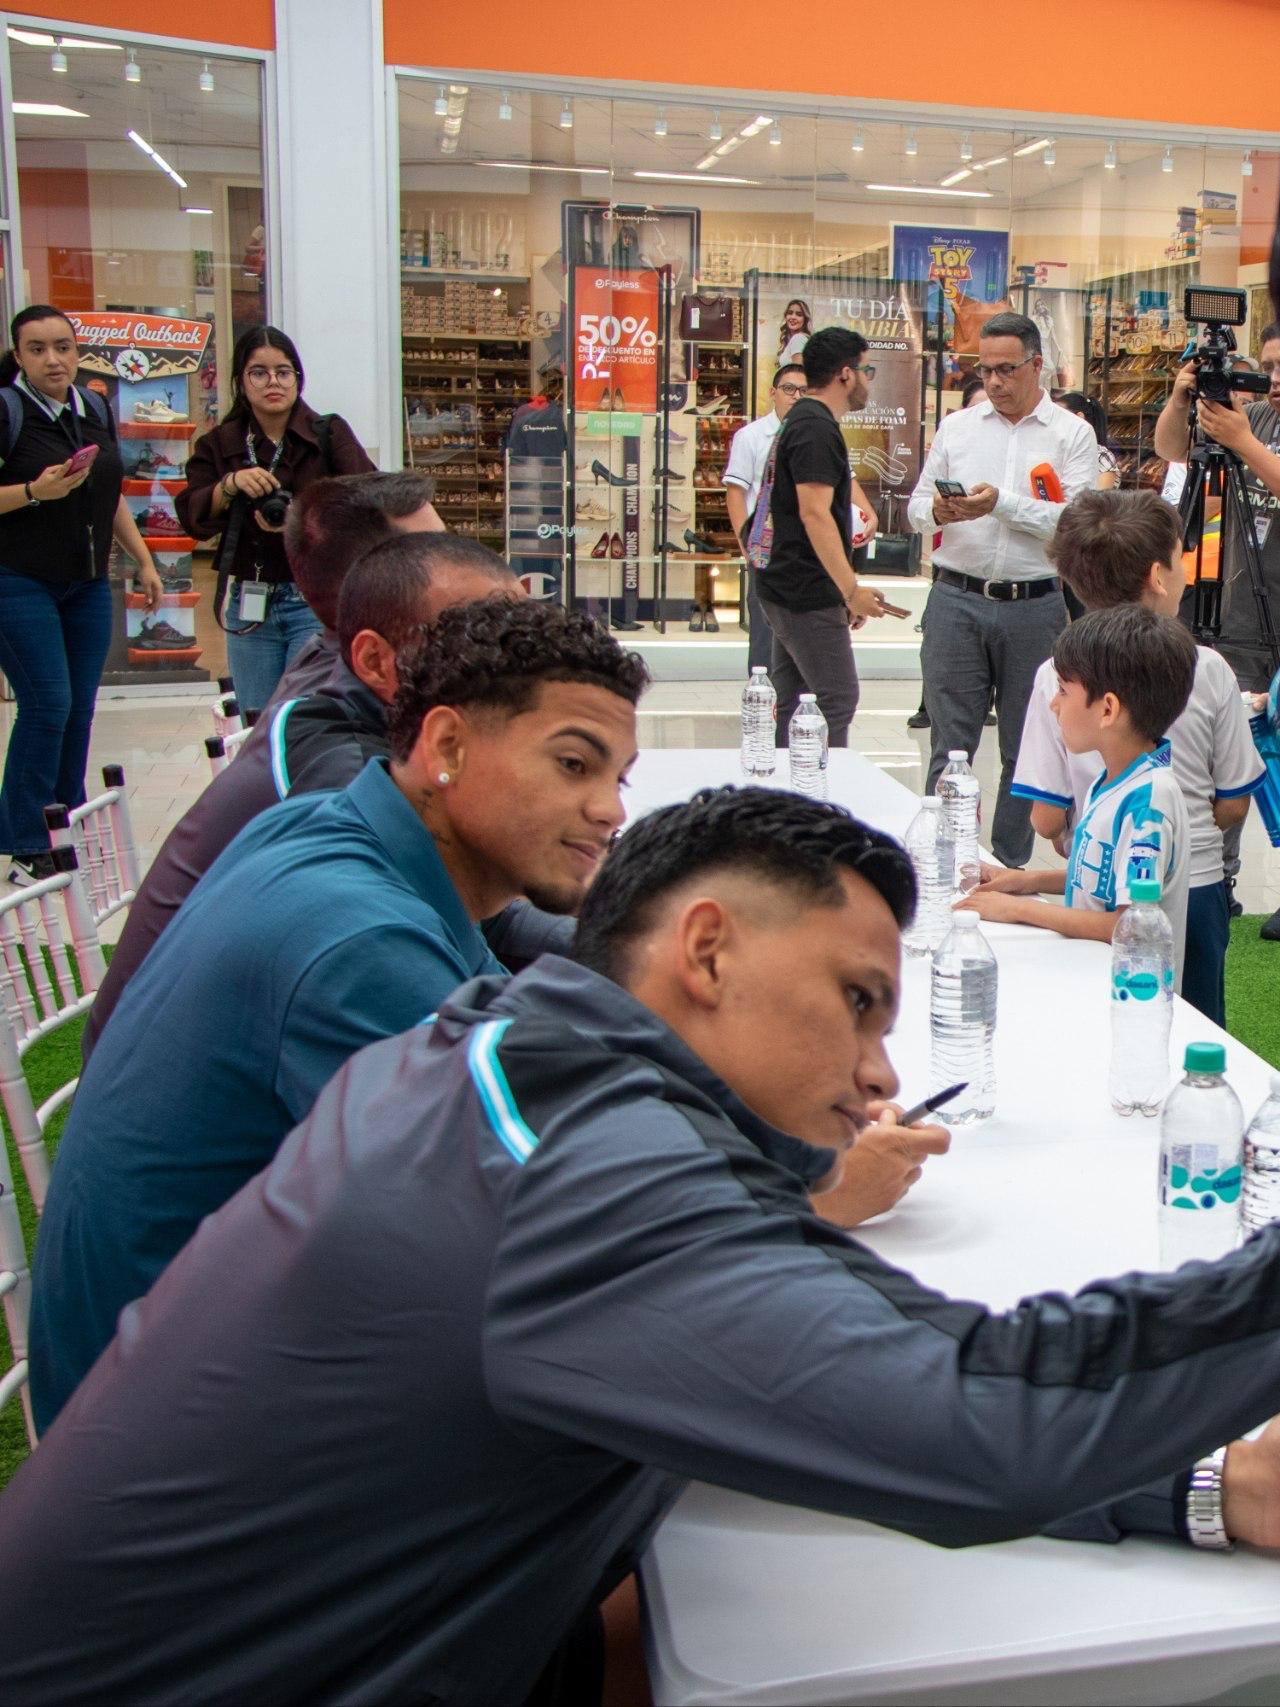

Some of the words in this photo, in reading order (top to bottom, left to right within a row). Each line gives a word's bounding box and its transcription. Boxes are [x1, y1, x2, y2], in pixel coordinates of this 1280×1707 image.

[928, 245, 976, 267] TOY
[943, 278, 958, 299] 5
[831, 299, 863, 320] TU
[869, 295, 911, 321] DÍA
[133, 322, 202, 344] Outback
[578, 314, 657, 347] 50%
[618, 355, 656, 365] ARTÍCULO
[643, 348, 656, 356] EN
[879, 416, 907, 425] FOAM
[626, 463, 638, 516] CHAMION
[625, 530, 638, 590] CHAMPIONS
